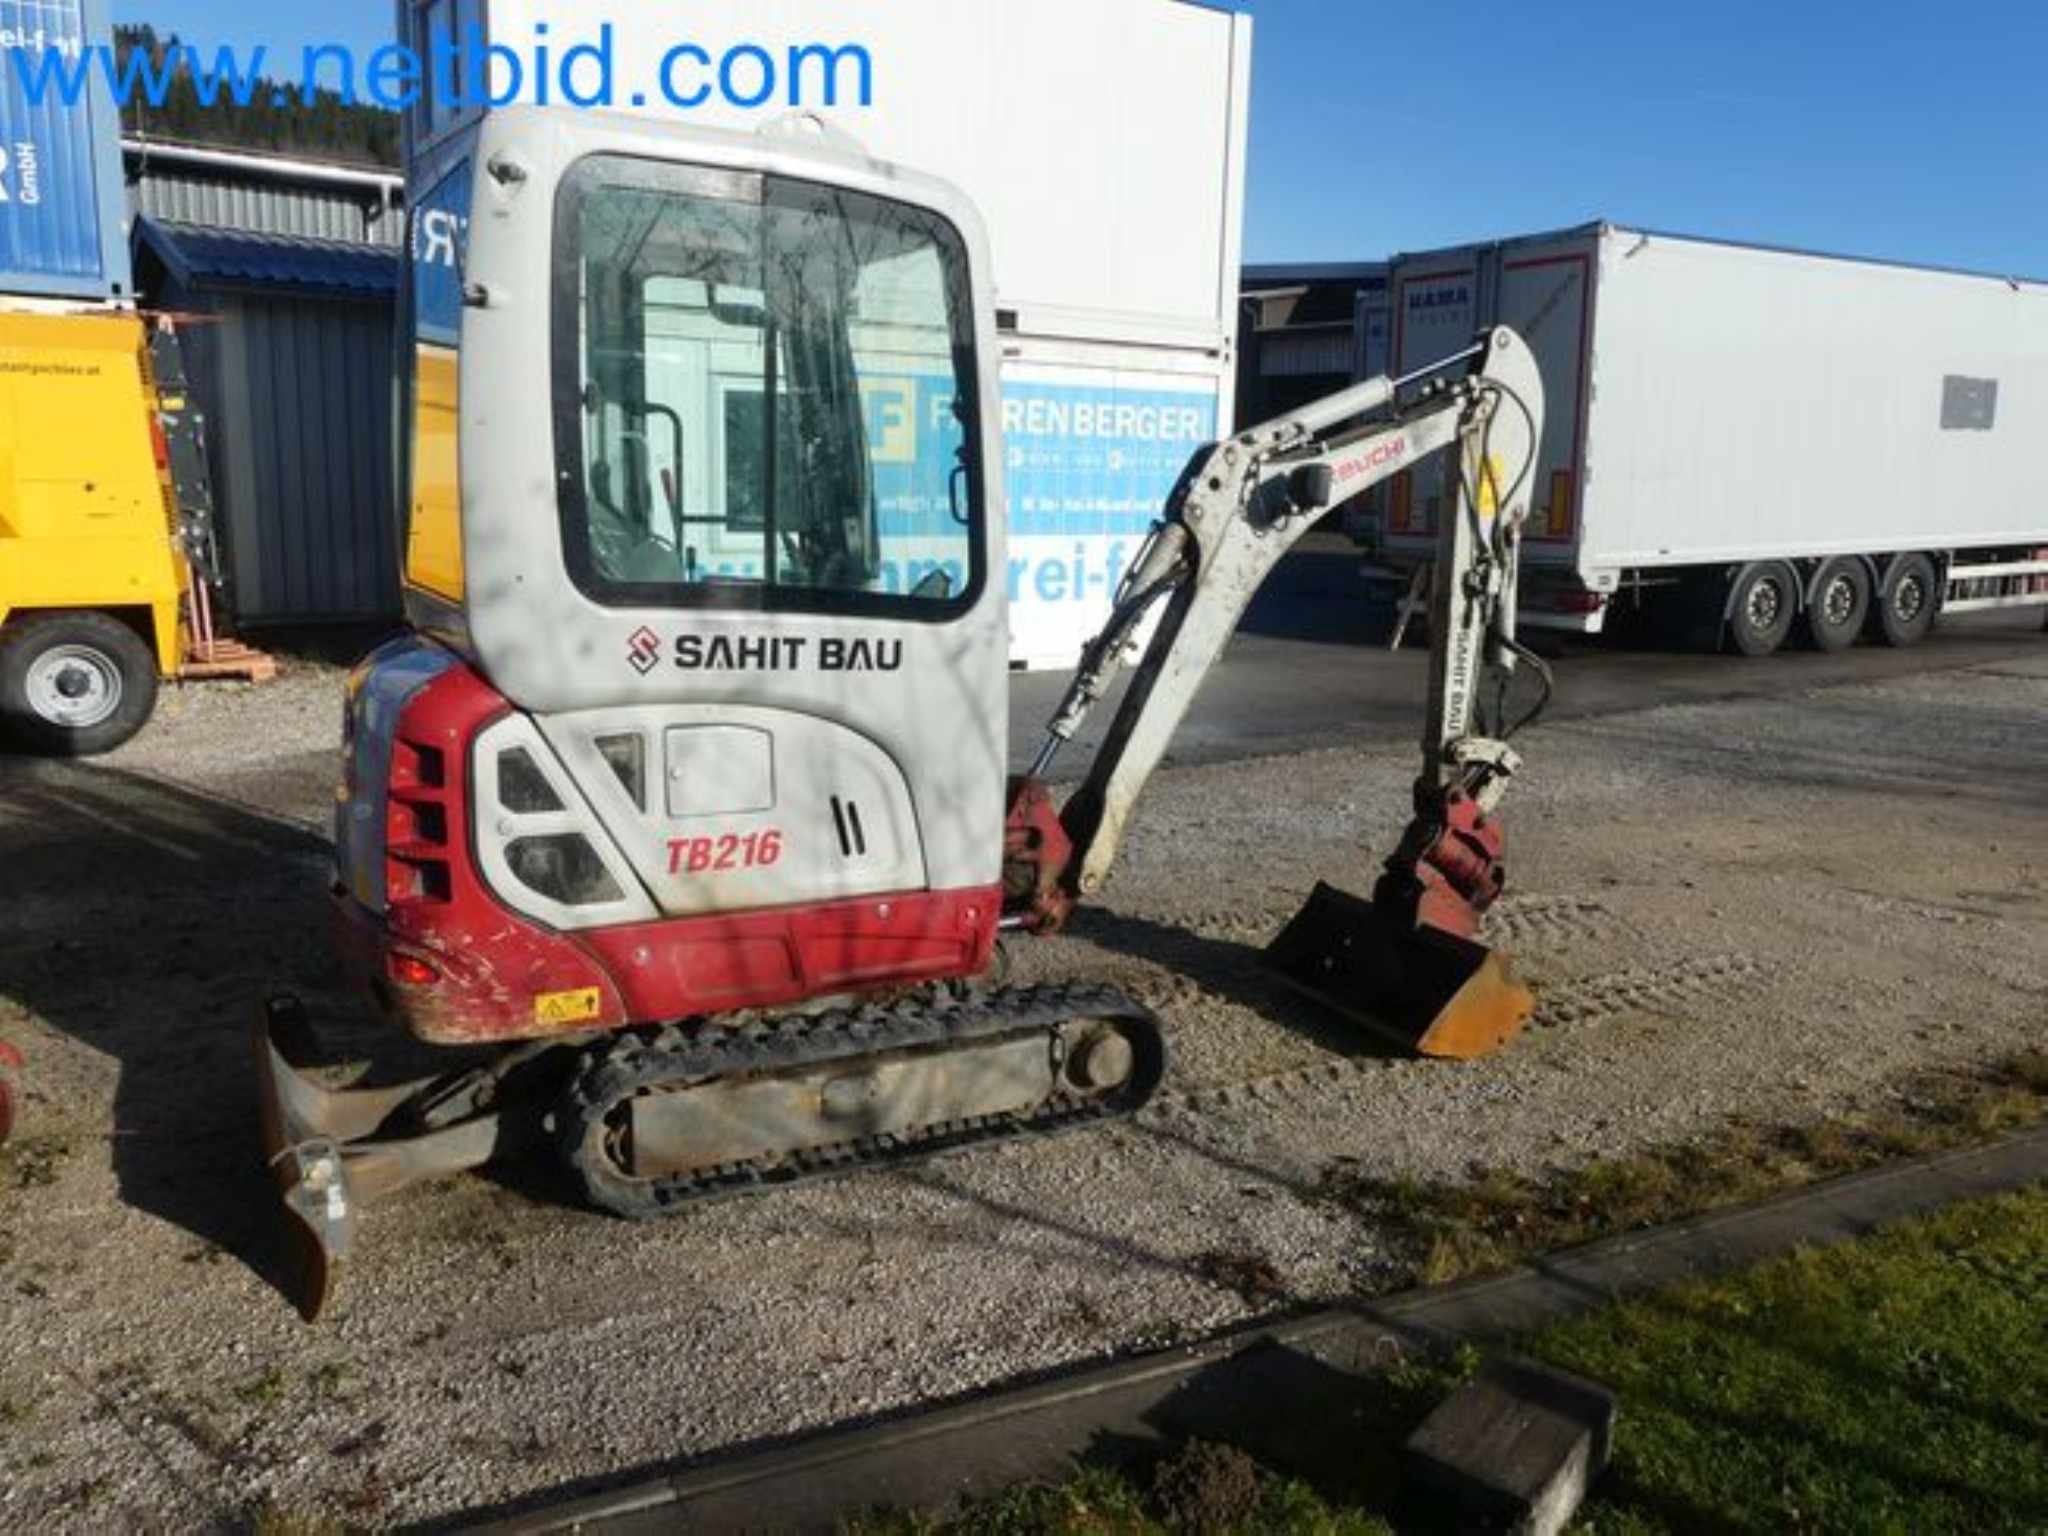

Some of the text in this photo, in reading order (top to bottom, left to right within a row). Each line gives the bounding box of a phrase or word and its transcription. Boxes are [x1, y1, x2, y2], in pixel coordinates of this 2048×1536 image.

[15, 142, 40, 205] GmbH
[930, 394, 1200, 440] FRENBERGER
[675, 634, 903, 671] SAHIT BAU
[1448, 631, 1470, 731] SAHIT BAU
[665, 830, 782, 875] TB216
